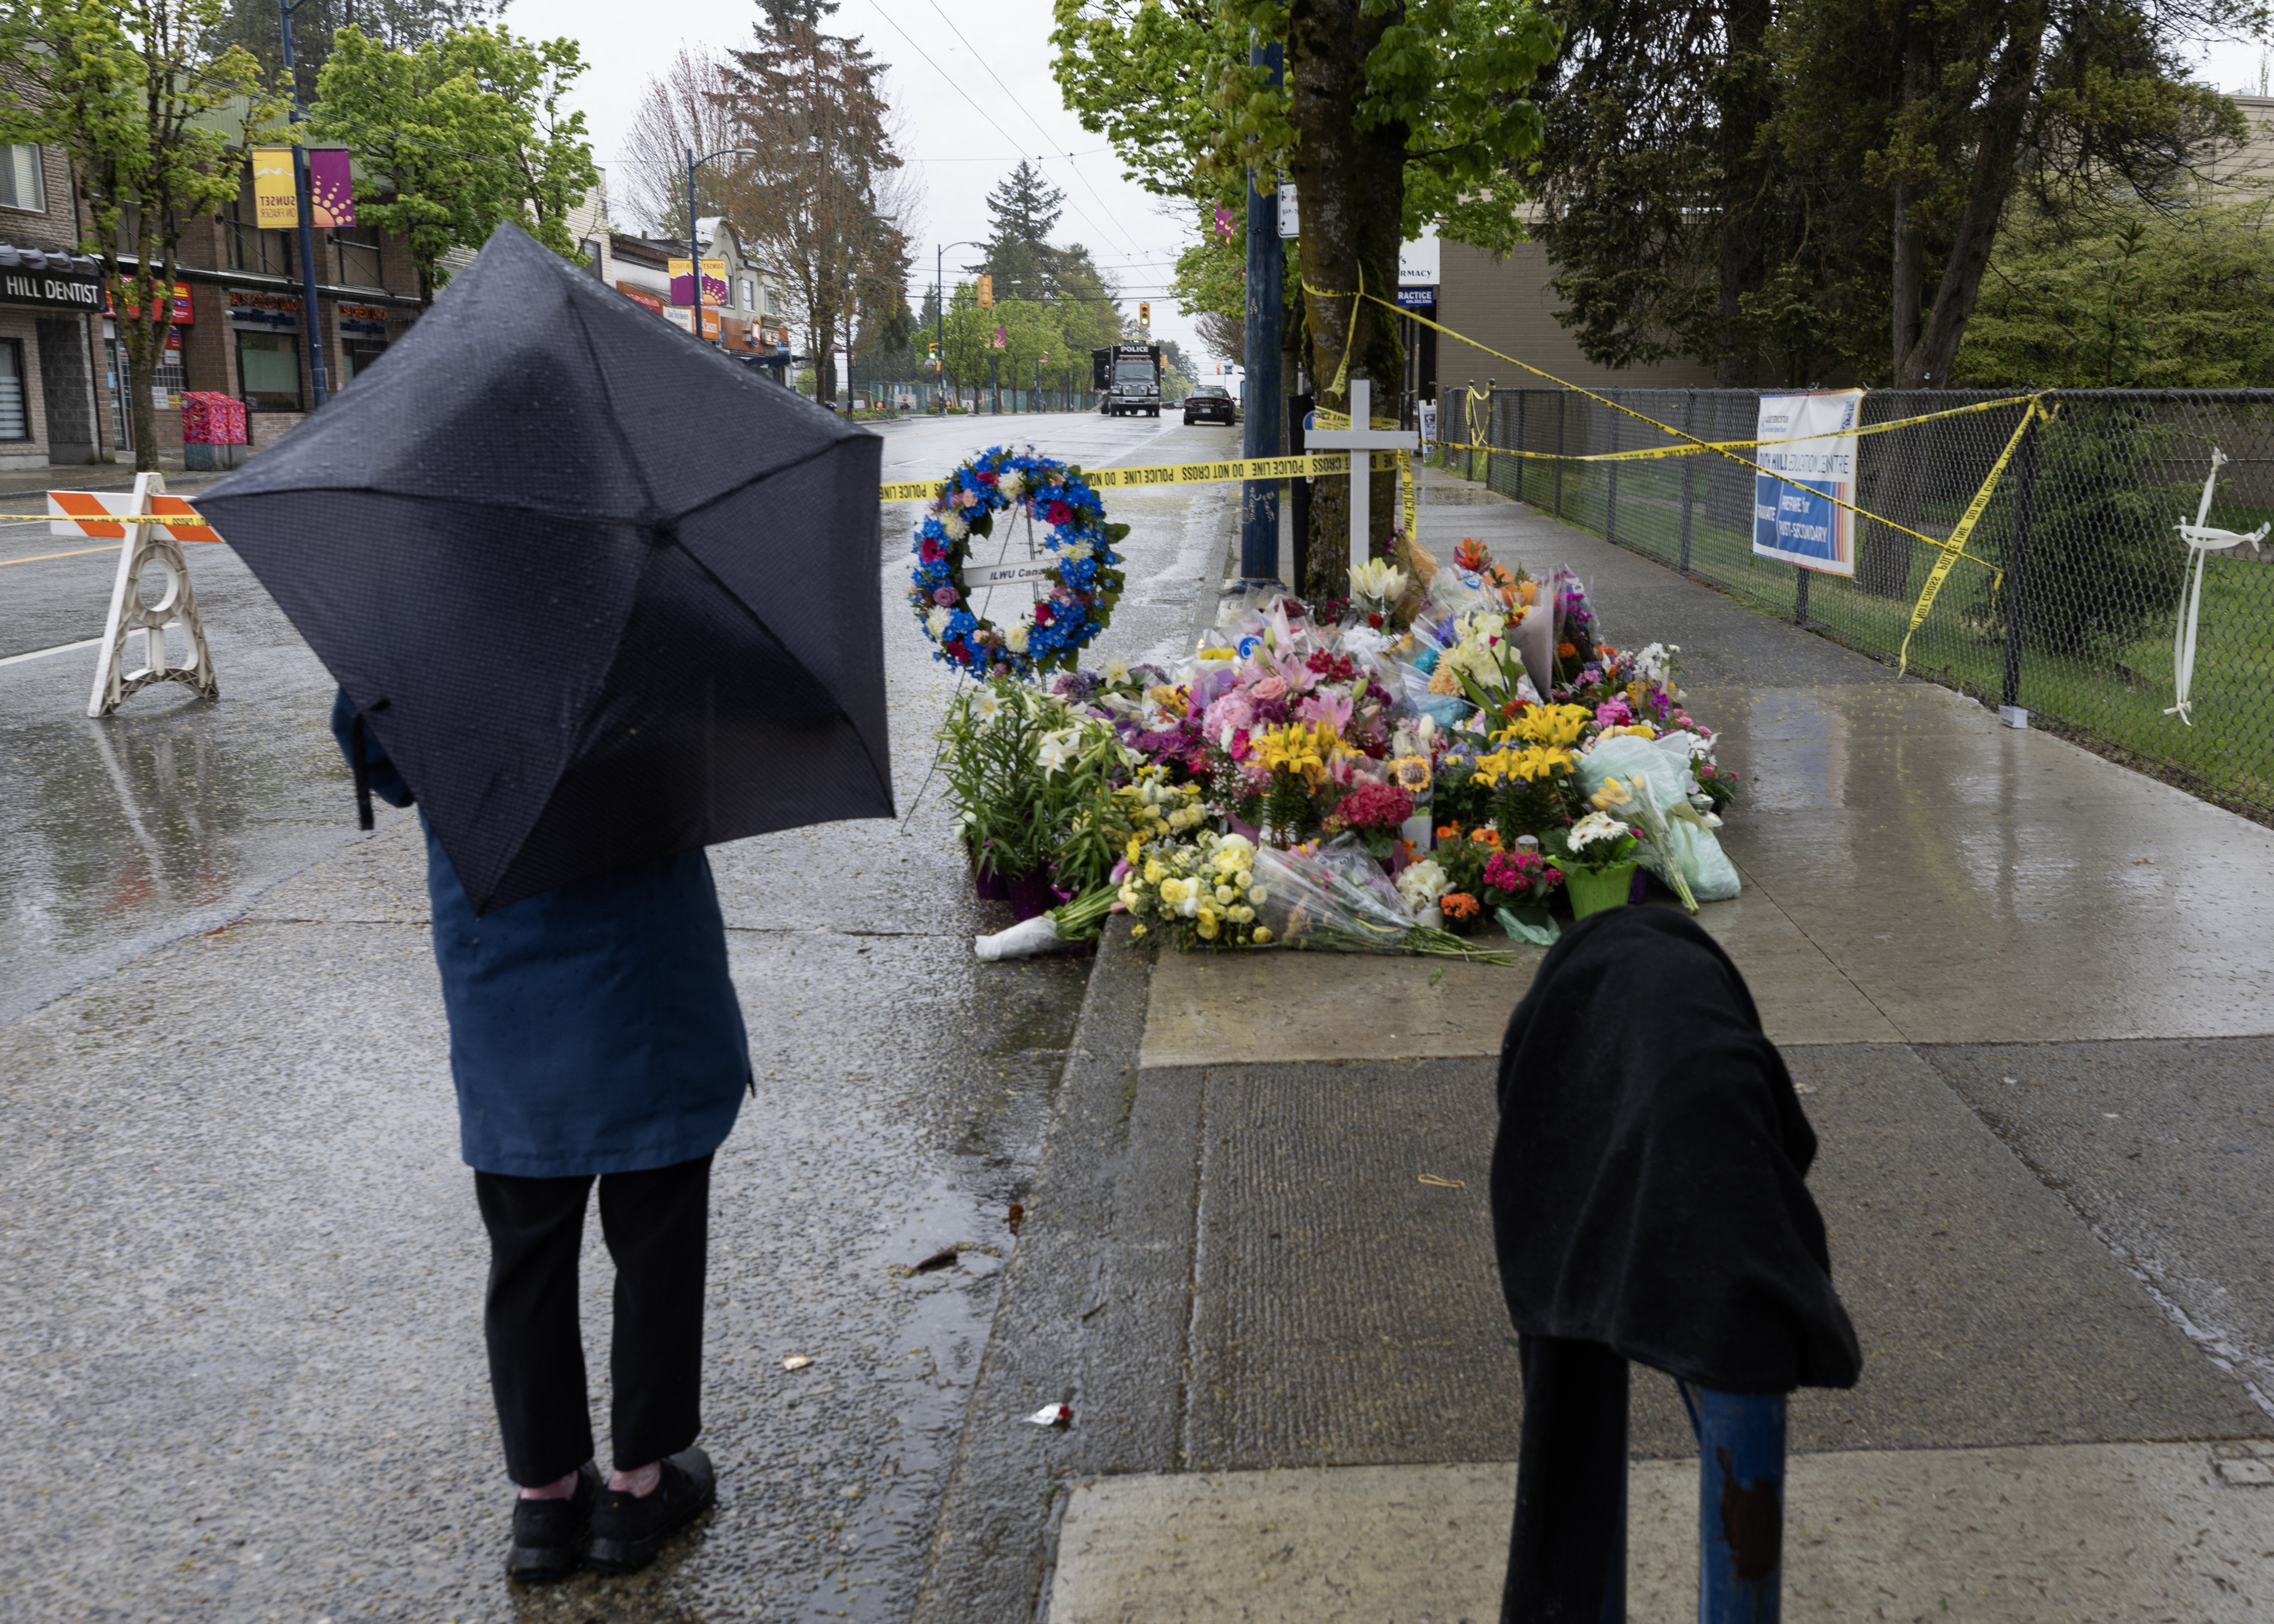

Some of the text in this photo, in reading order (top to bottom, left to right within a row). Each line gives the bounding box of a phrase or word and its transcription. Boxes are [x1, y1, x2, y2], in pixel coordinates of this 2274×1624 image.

[6, 275, 42, 298] HILL
[44, 279, 98, 304] DENTIST
[1398, 291, 1432, 300] RACTICE
[1182, 459, 1303, 480] POLICE LINE DO NOT CROSS
[1313, 456, 1342, 472] CROSS
[1818, 454, 1849, 474] CENTRE
[1105, 472, 1116, 485] DO
[1124, 471, 1142, 485] LINE
[1144, 468, 1174, 483] POLICE
[879, 486, 897, 499] LINE
[899, 484, 927, 499] POLICE
[1778, 520, 1828, 543] POST-SECONDARY
[990, 569, 1015, 580] ILWU
